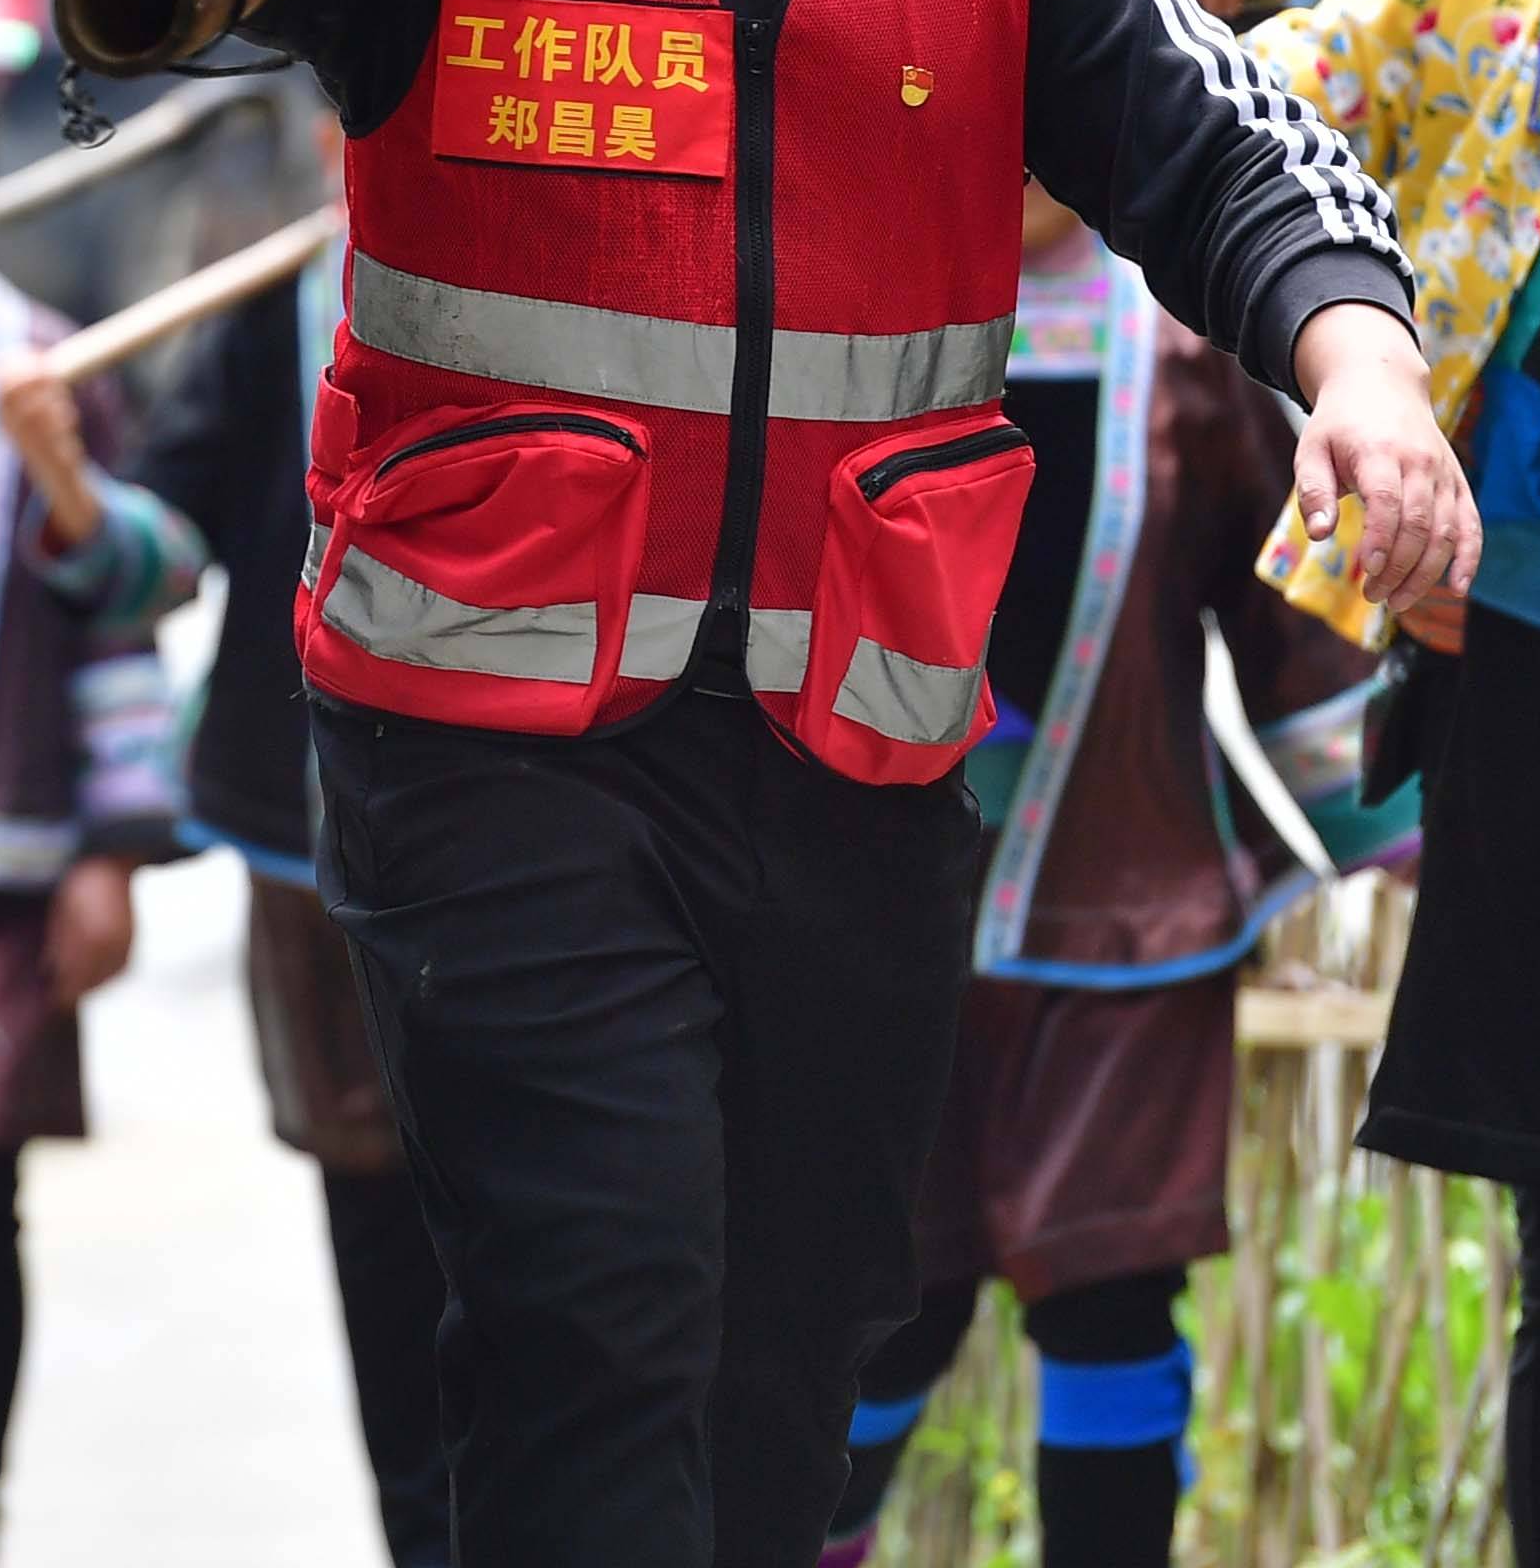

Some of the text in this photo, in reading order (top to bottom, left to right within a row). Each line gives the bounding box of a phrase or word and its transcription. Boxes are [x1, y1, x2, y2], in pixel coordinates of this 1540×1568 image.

[445, 15, 710, 93] 工作队员
[487, 94, 657, 162] 郑昌昊
